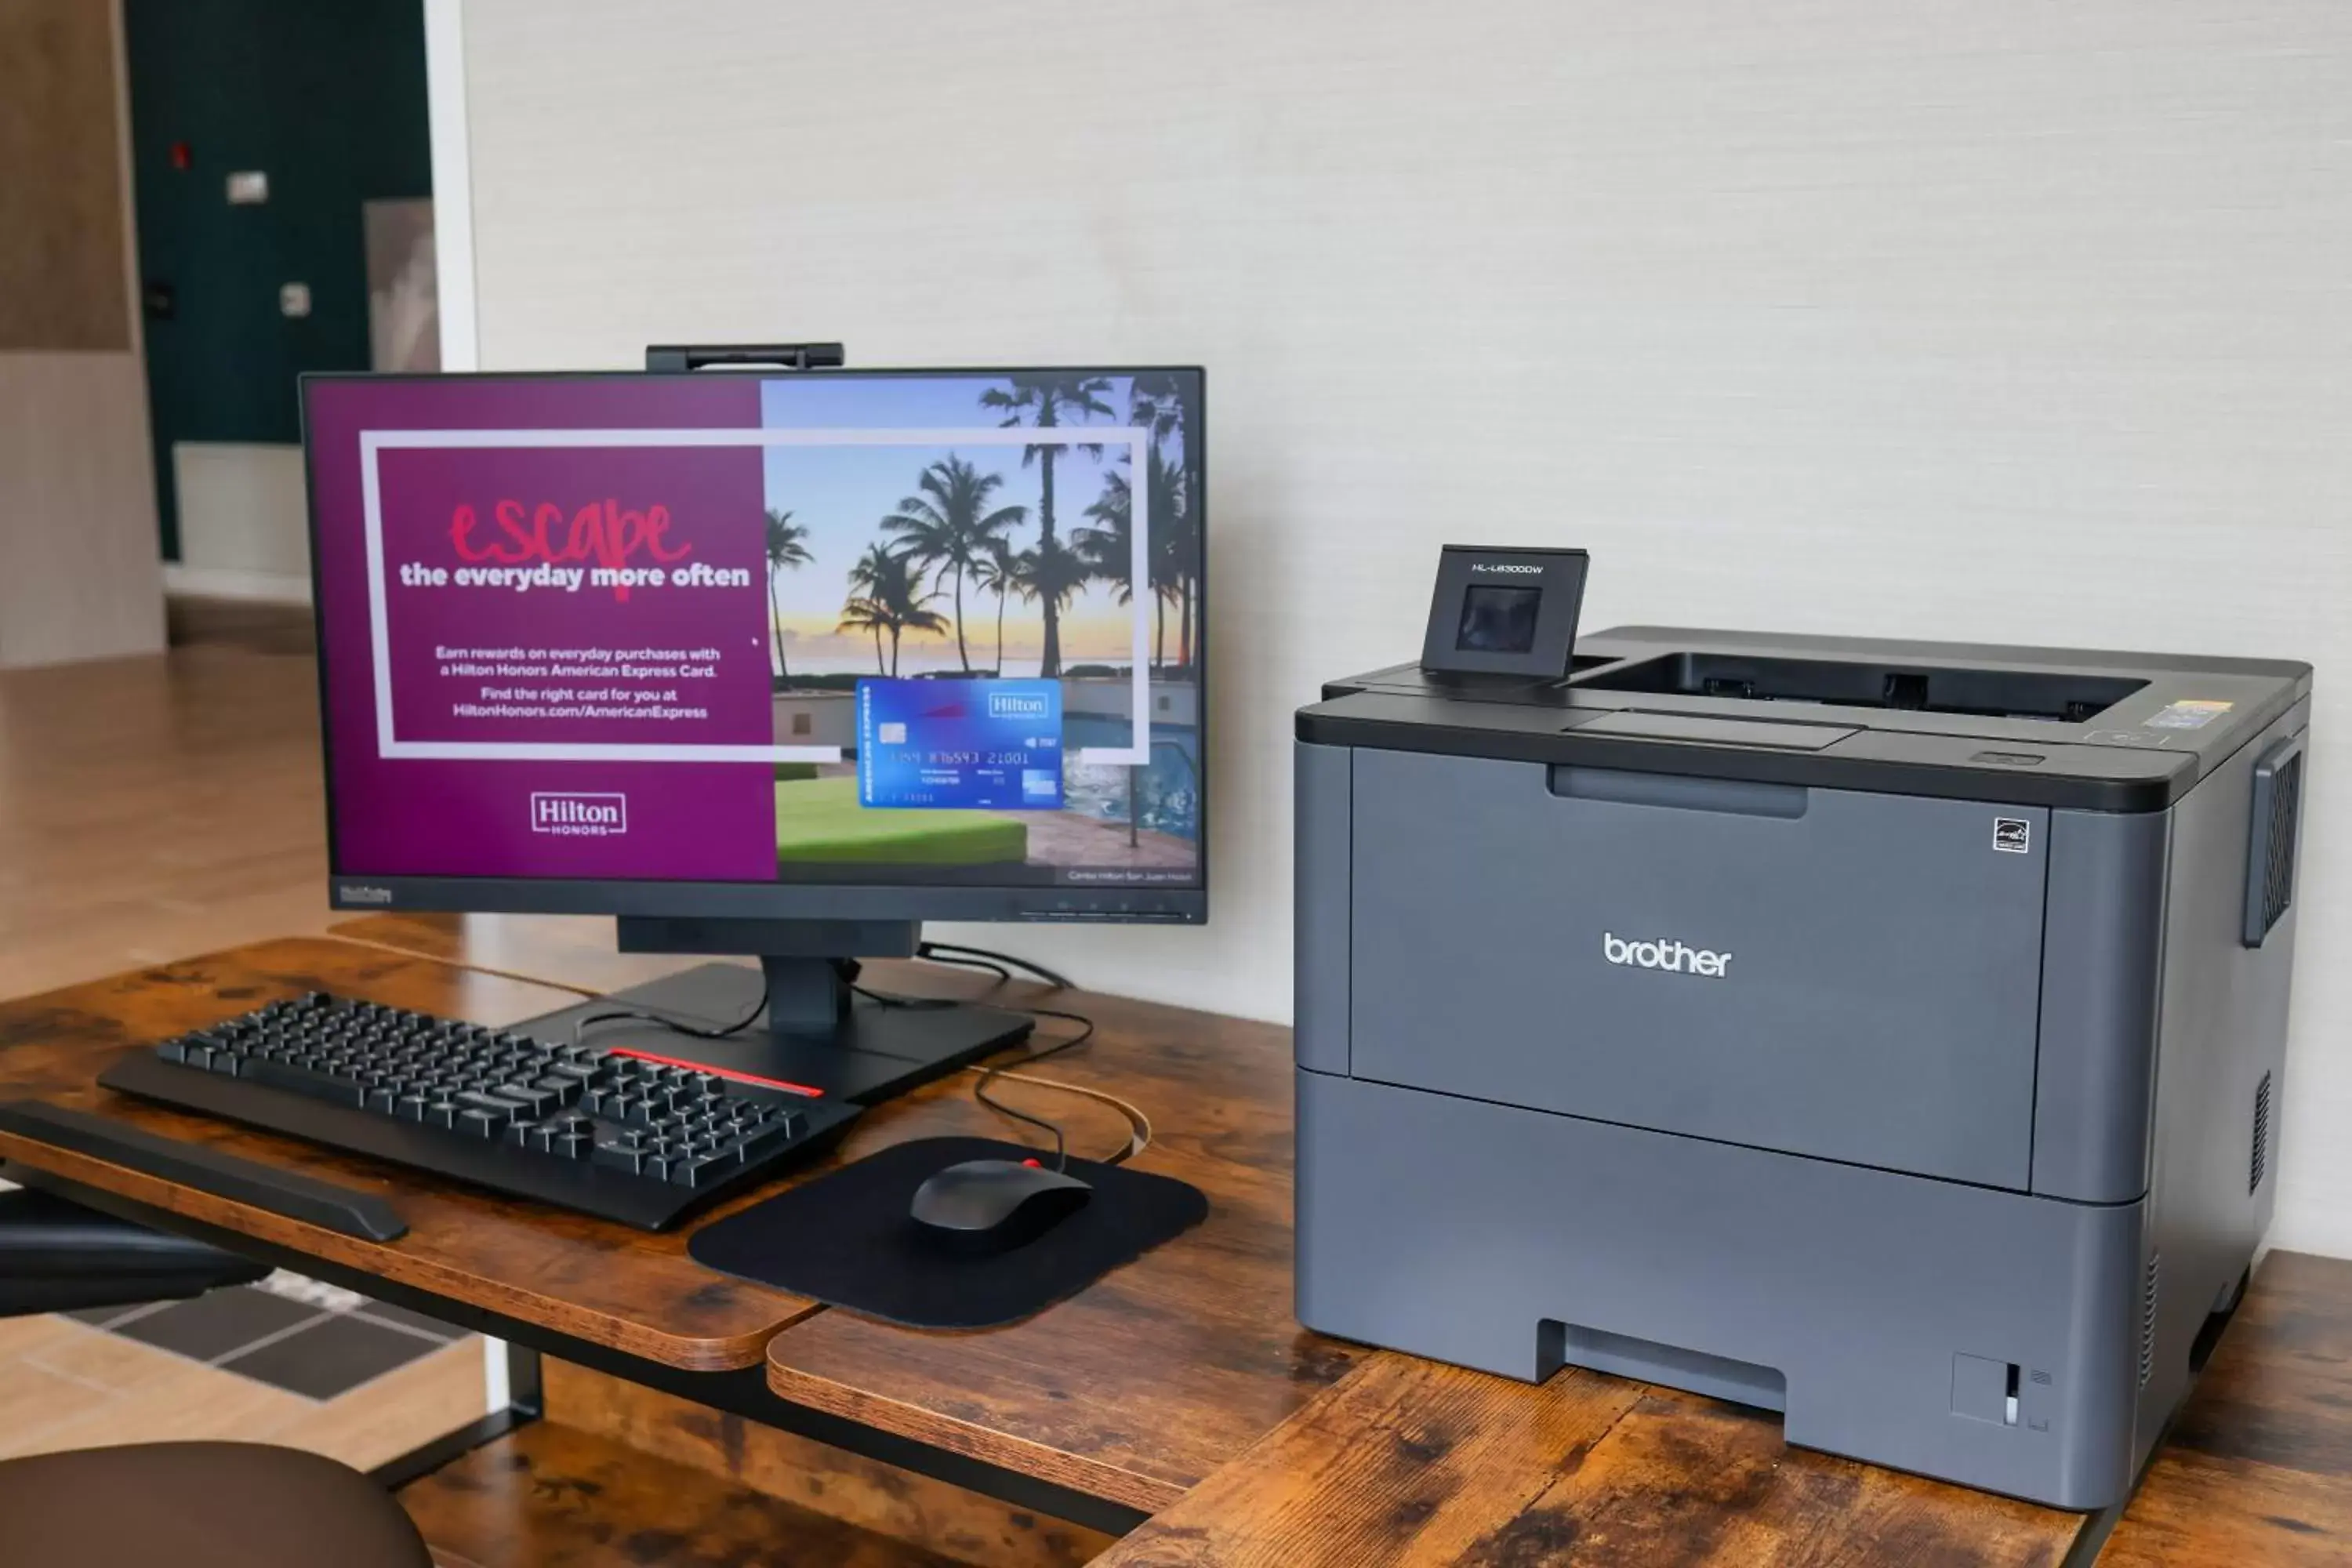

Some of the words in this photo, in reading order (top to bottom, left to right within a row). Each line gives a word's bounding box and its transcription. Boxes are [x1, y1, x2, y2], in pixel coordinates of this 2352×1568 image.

[449, 499, 691, 603] escape
[400, 562, 448, 586] the
[454, 562, 584, 592] everyday
[592, 566, 665, 586] more
[672, 562, 750, 586] often
[436, 644, 468, 659] Earn
[470, 646, 525, 660] rewards
[528, 648, 546, 659] on
[549, 647, 613, 662] everyday
[615, 648, 687, 662] purchases
[688, 647, 720, 660] with
[440, 665, 449, 676] a
[451, 663, 495, 676] Hilton
[496, 663, 547, 677] Honors
[551, 664, 619, 677] American
[621, 665, 677, 680] Express
[679, 665, 718, 677] Card.
[481, 687, 512, 700] Find
[514, 688, 538, 700] the
[540, 688, 574, 702] right
[577, 688, 608, 701] card
[611, 688, 630, 701] for
[633, 690, 660, 704] you
[662, 690, 677, 701] at
[452, 703, 709, 720] HiltonHonors.com/AmericanExpress
[994, 697, 1042, 712] Hilton
[539, 800, 618, 822] Hilton
[551, 825, 608, 837] HONORS
[1604, 932, 1732, 977] brother
